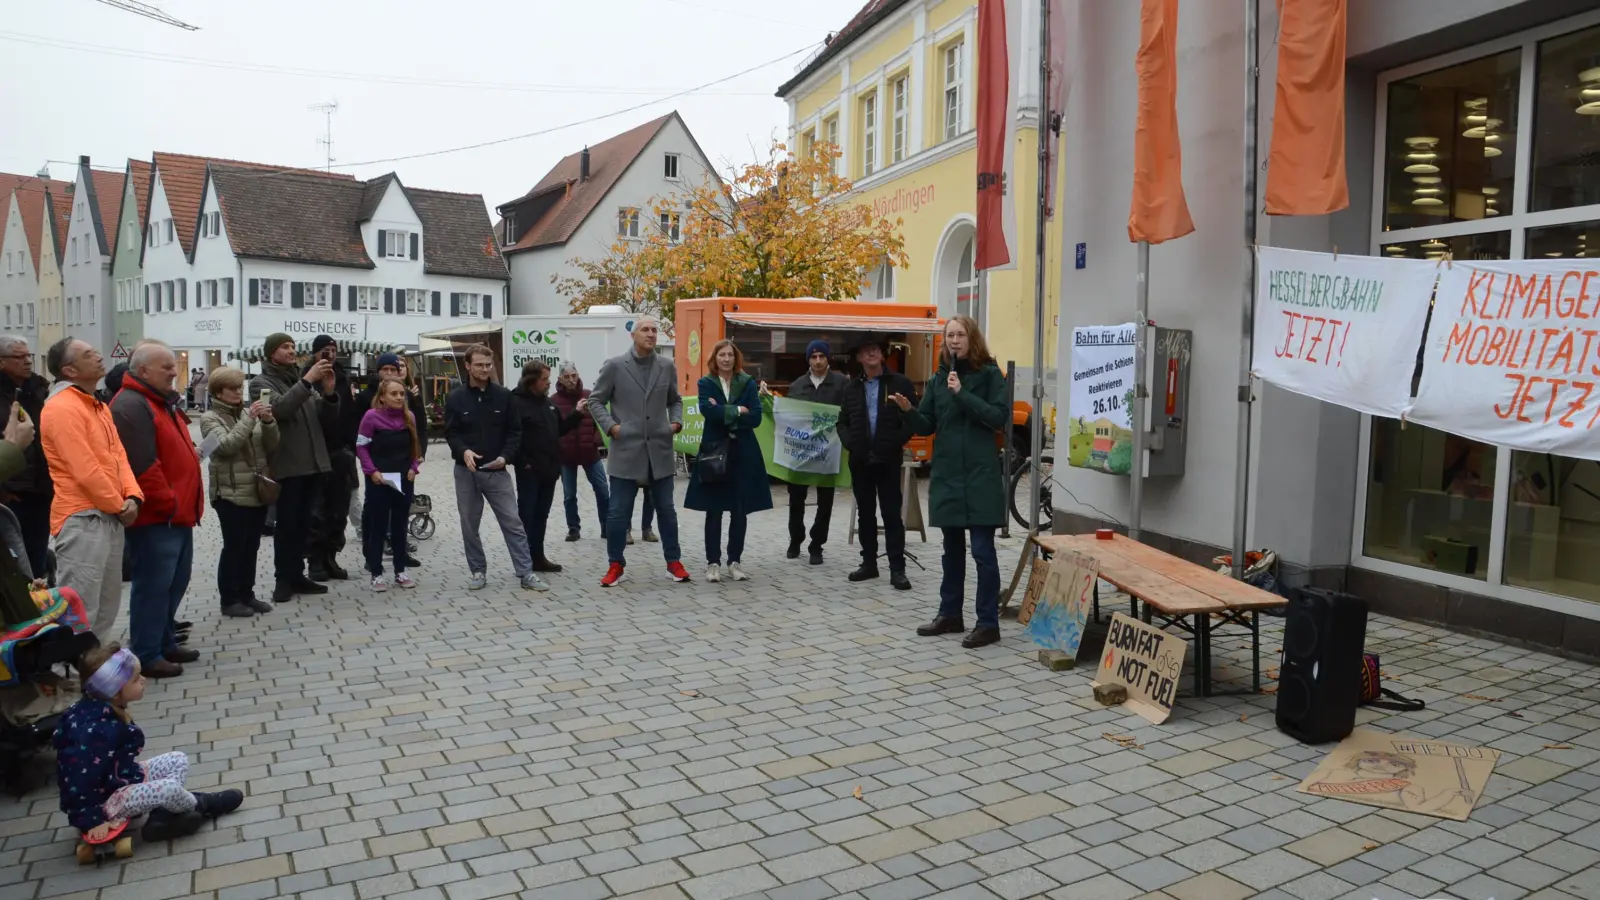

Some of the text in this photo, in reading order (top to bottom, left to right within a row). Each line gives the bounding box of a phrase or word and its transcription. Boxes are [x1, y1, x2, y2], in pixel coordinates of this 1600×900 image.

[873, 184, 935, 218] Nördlingen
[1269, 270, 1383, 313] HESSELBERGBAHN
[284, 320, 357, 334] HOSENECKE
[1075, 331, 1099, 344] Bahn
[1101, 331, 1115, 344] für
[1275, 310, 1350, 367] JETZT!
[513, 354, 560, 368] Schller
[1074, 356, 1134, 381] Gemeinsam die Schiene
[1088, 378, 1122, 394] Reaktivieren
[1093, 395, 1121, 414] 26.10.
[785, 426, 809, 440] BUND
[1109, 619, 1164, 661] BURN FAT
[1117, 655, 1174, 709] NOT FUEL
